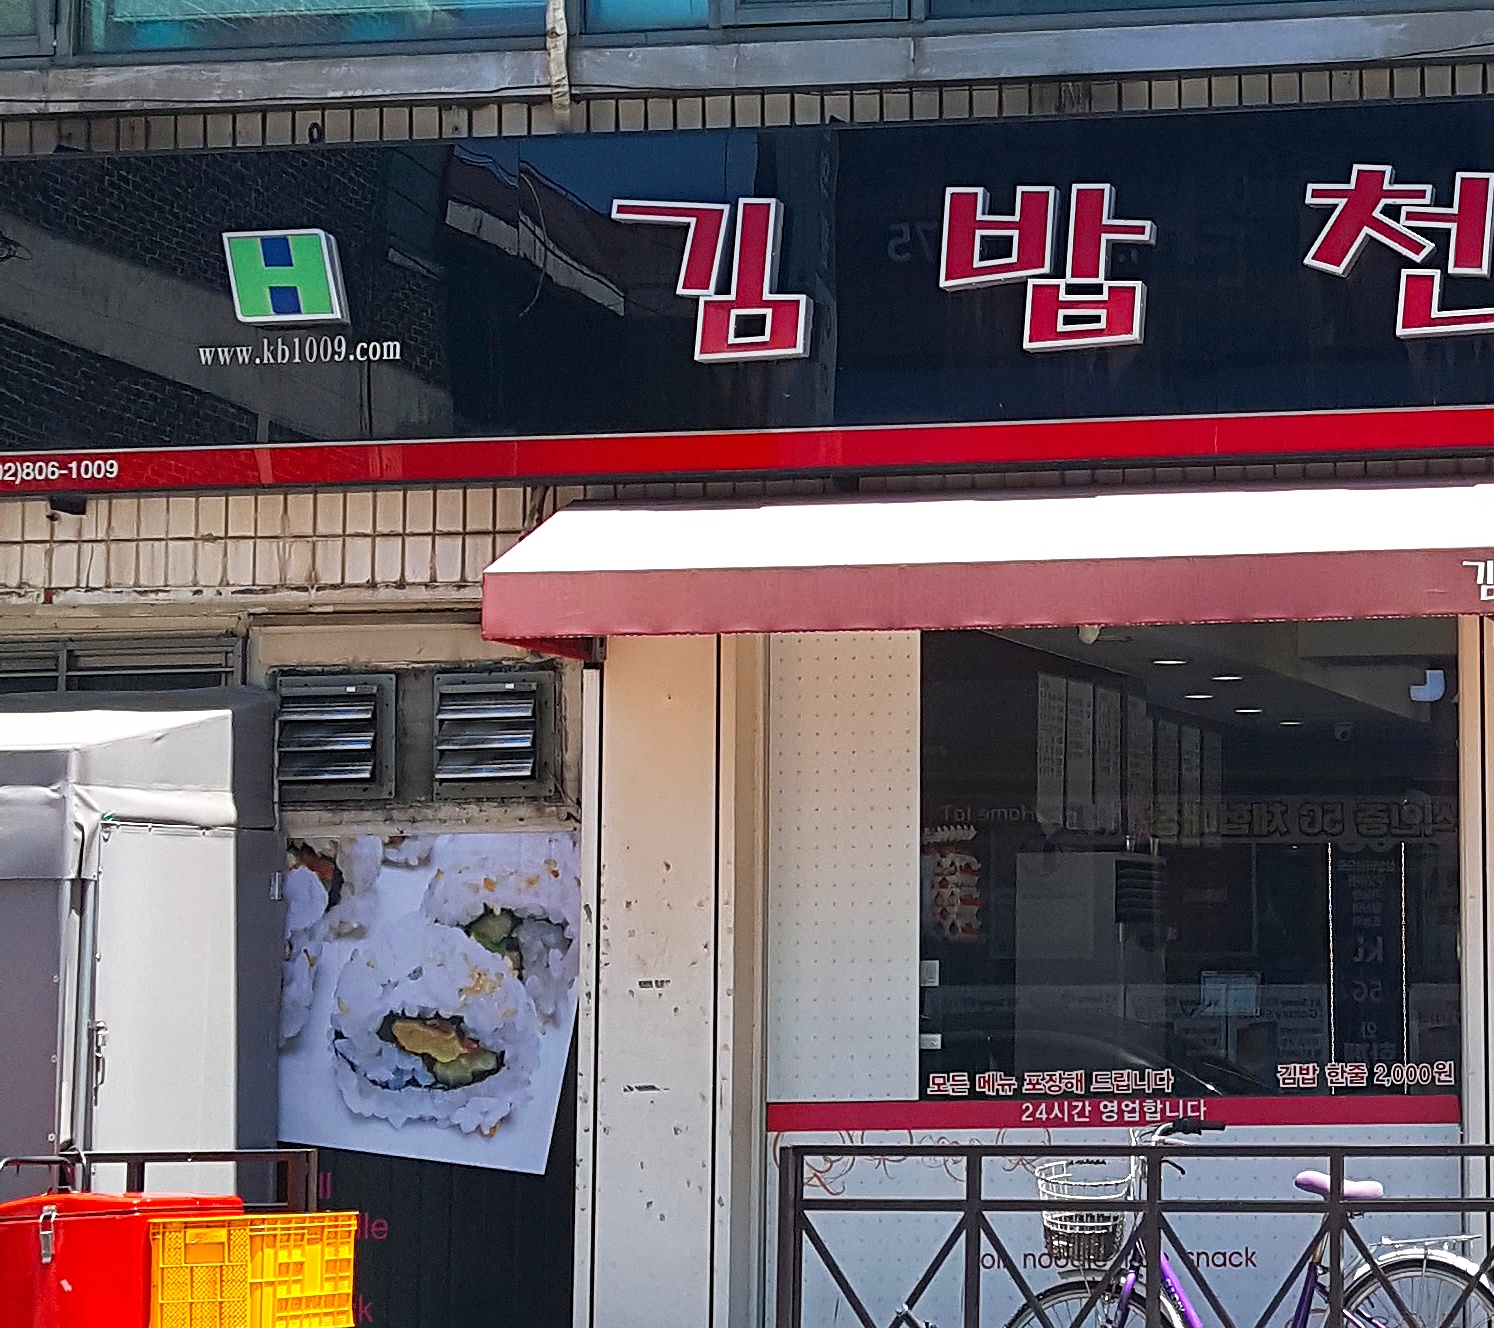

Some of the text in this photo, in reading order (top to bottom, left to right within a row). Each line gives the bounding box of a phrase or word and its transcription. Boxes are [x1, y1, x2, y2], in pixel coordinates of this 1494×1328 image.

[199, 335, 402, 366] www.kb1009.com
[0, 460, 119, 484] 2)806-1009
[927, 1068, 1174, 1096] 모든 메뉴 포장해 드립니다
[1277, 1063, 1319, 1087] 김밥
[1325, 1062, 1368, 1087] 한줄
[1021, 1099, 1208, 1123] 24시간 영업합니다
